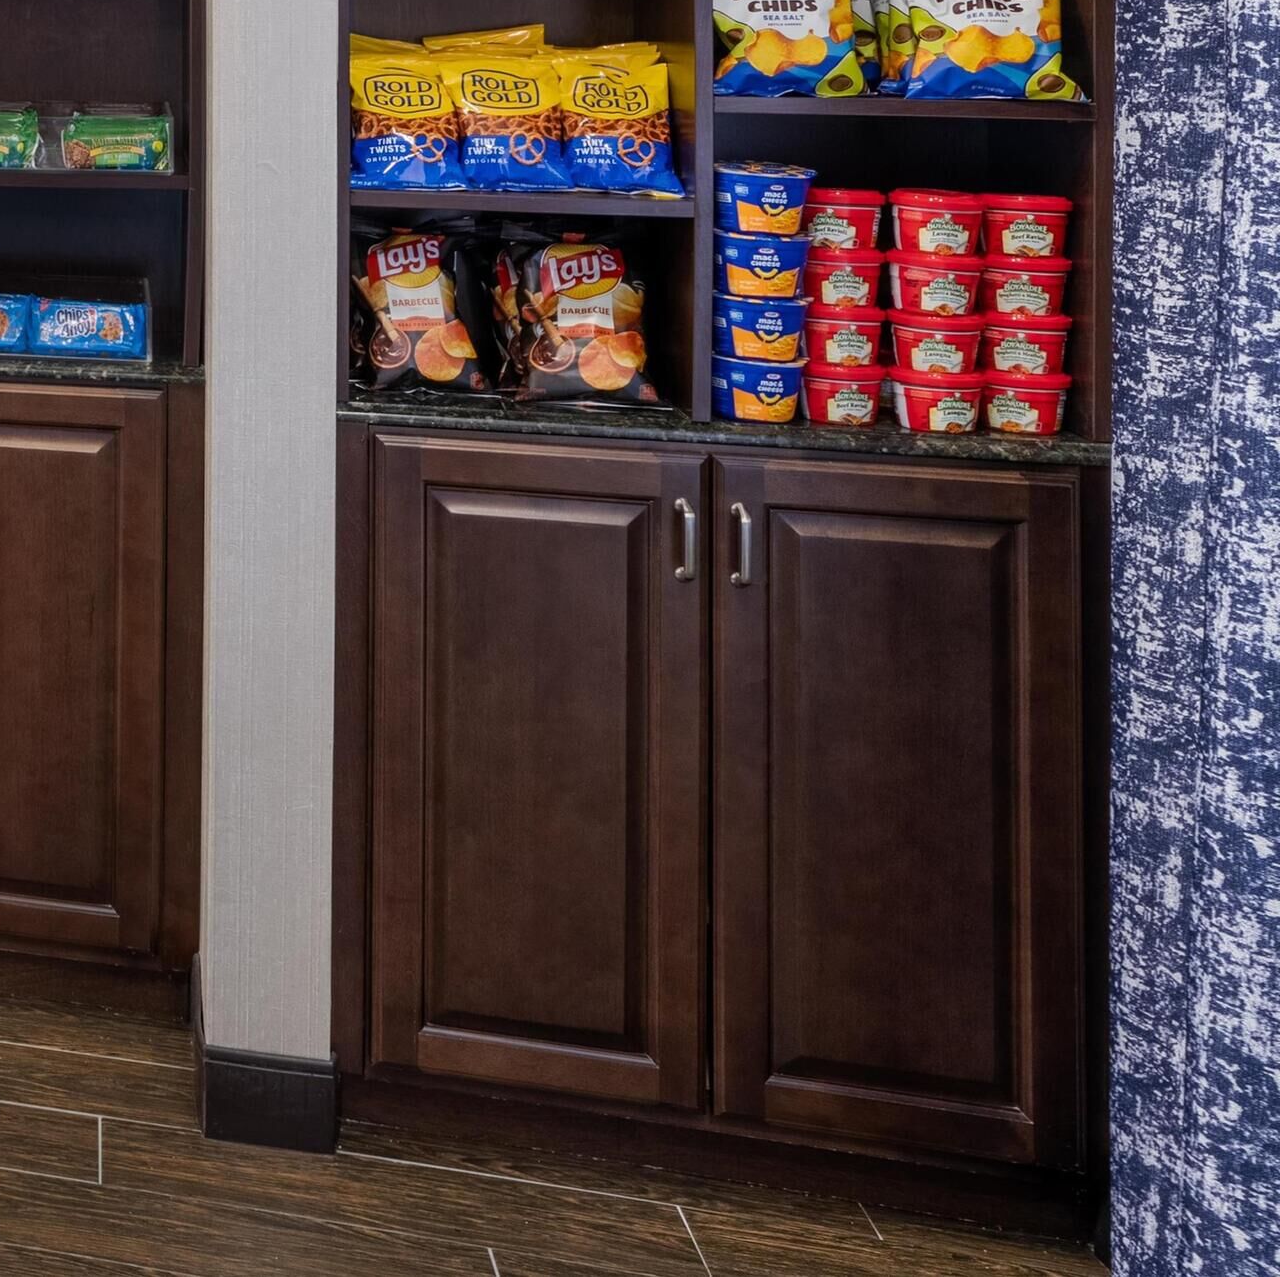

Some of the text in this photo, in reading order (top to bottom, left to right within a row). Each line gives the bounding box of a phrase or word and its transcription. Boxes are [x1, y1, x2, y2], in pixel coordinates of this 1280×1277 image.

[747, 0, 819, 12] CHIPS
[951, 1, 1024, 14] CHIPS
[783, 13, 805, 21] SALT
[373, 81, 432, 94] ROLD
[472, 77, 530, 91] ROLD
[374, 93, 435, 107] GOLD
[471, 89, 532, 104] GOLD
[369, 145, 406, 154] TWISTS
[467, 146, 505, 155] TWISTS
[377, 236, 440, 278] Lay's
[549, 248, 617, 293] Lay's
[391, 296, 440, 308] BARBECUE
[56, 308, 89, 323] Chips
[561, 305, 611, 317] BARBECUE
